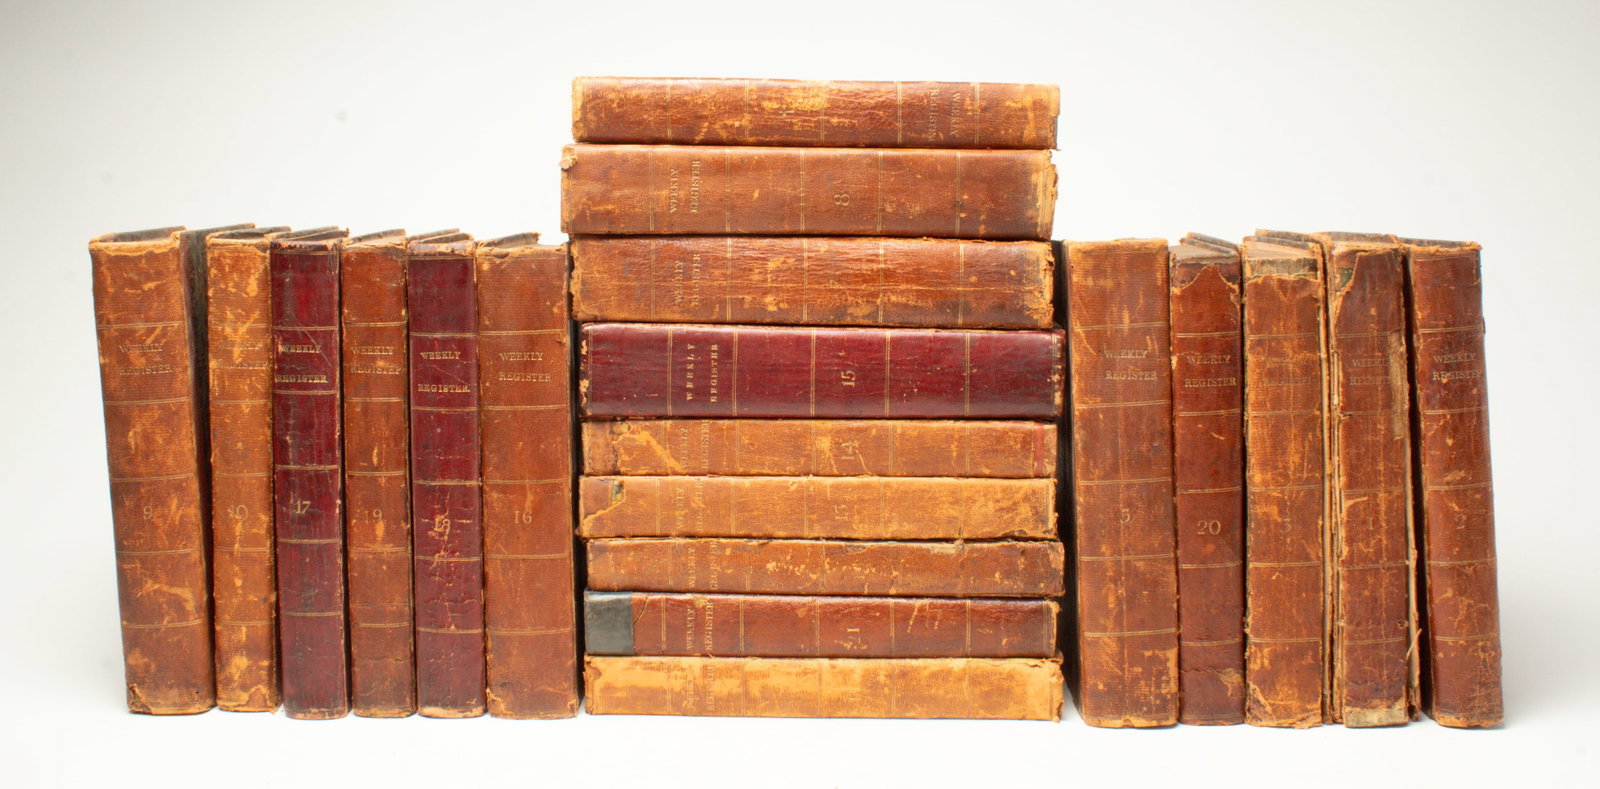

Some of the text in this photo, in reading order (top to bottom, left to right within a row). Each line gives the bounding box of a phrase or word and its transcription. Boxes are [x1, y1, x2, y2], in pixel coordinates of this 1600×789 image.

[950, 91, 961, 138] WEEKLY
[669, 168, 680, 214] WEEKLY
[689, 159, 701, 213] REGISTER
[833, 193, 850, 207] 8
[119, 343, 164, 354] WEEKLY
[281, 344, 322, 354] WEEKLY
[351, 345, 394, 356] WEEKLY
[1104, 349, 1149, 360] WEEKLY
[420, 351, 461, 361] WEEKLY
[499, 351, 544, 362] WEEKLY
[1186, 355, 1231, 365] WEEKLY
[1351, 357, 1389, 368] WEEKL
[1433, 352, 1477, 364] WEEKLY
[119, 364, 173, 376] REGISTER
[350, 364, 403, 376] REGISTER
[499, 371, 552, 383] REGISTER
[686, 343, 696, 401] WEEKLY
[710, 344, 719, 404] REGISTER
[1105, 370, 1158, 381] REGISTER
[840, 370, 856, 388] 15
[1184, 377, 1237, 388] REGISTER
[680, 427, 689, 471] WEEKLY
[701, 419, 710, 470] REGISTER
[143, 505, 153, 520] 9
[294, 500, 312, 514] 17
[363, 508, 383, 524] 19
[514, 509, 533, 525] 16
[1120, 508, 1131, 524] 5
[1366, 516, 1375, 530] 1
[1455, 514, 1467, 530] 2
[1197, 519, 1222, 536] 20
[687, 546, 697, 588] WEEKLY
[686, 608, 696, 650] WEEKLY
[704, 600, 714, 651] REGISTER
